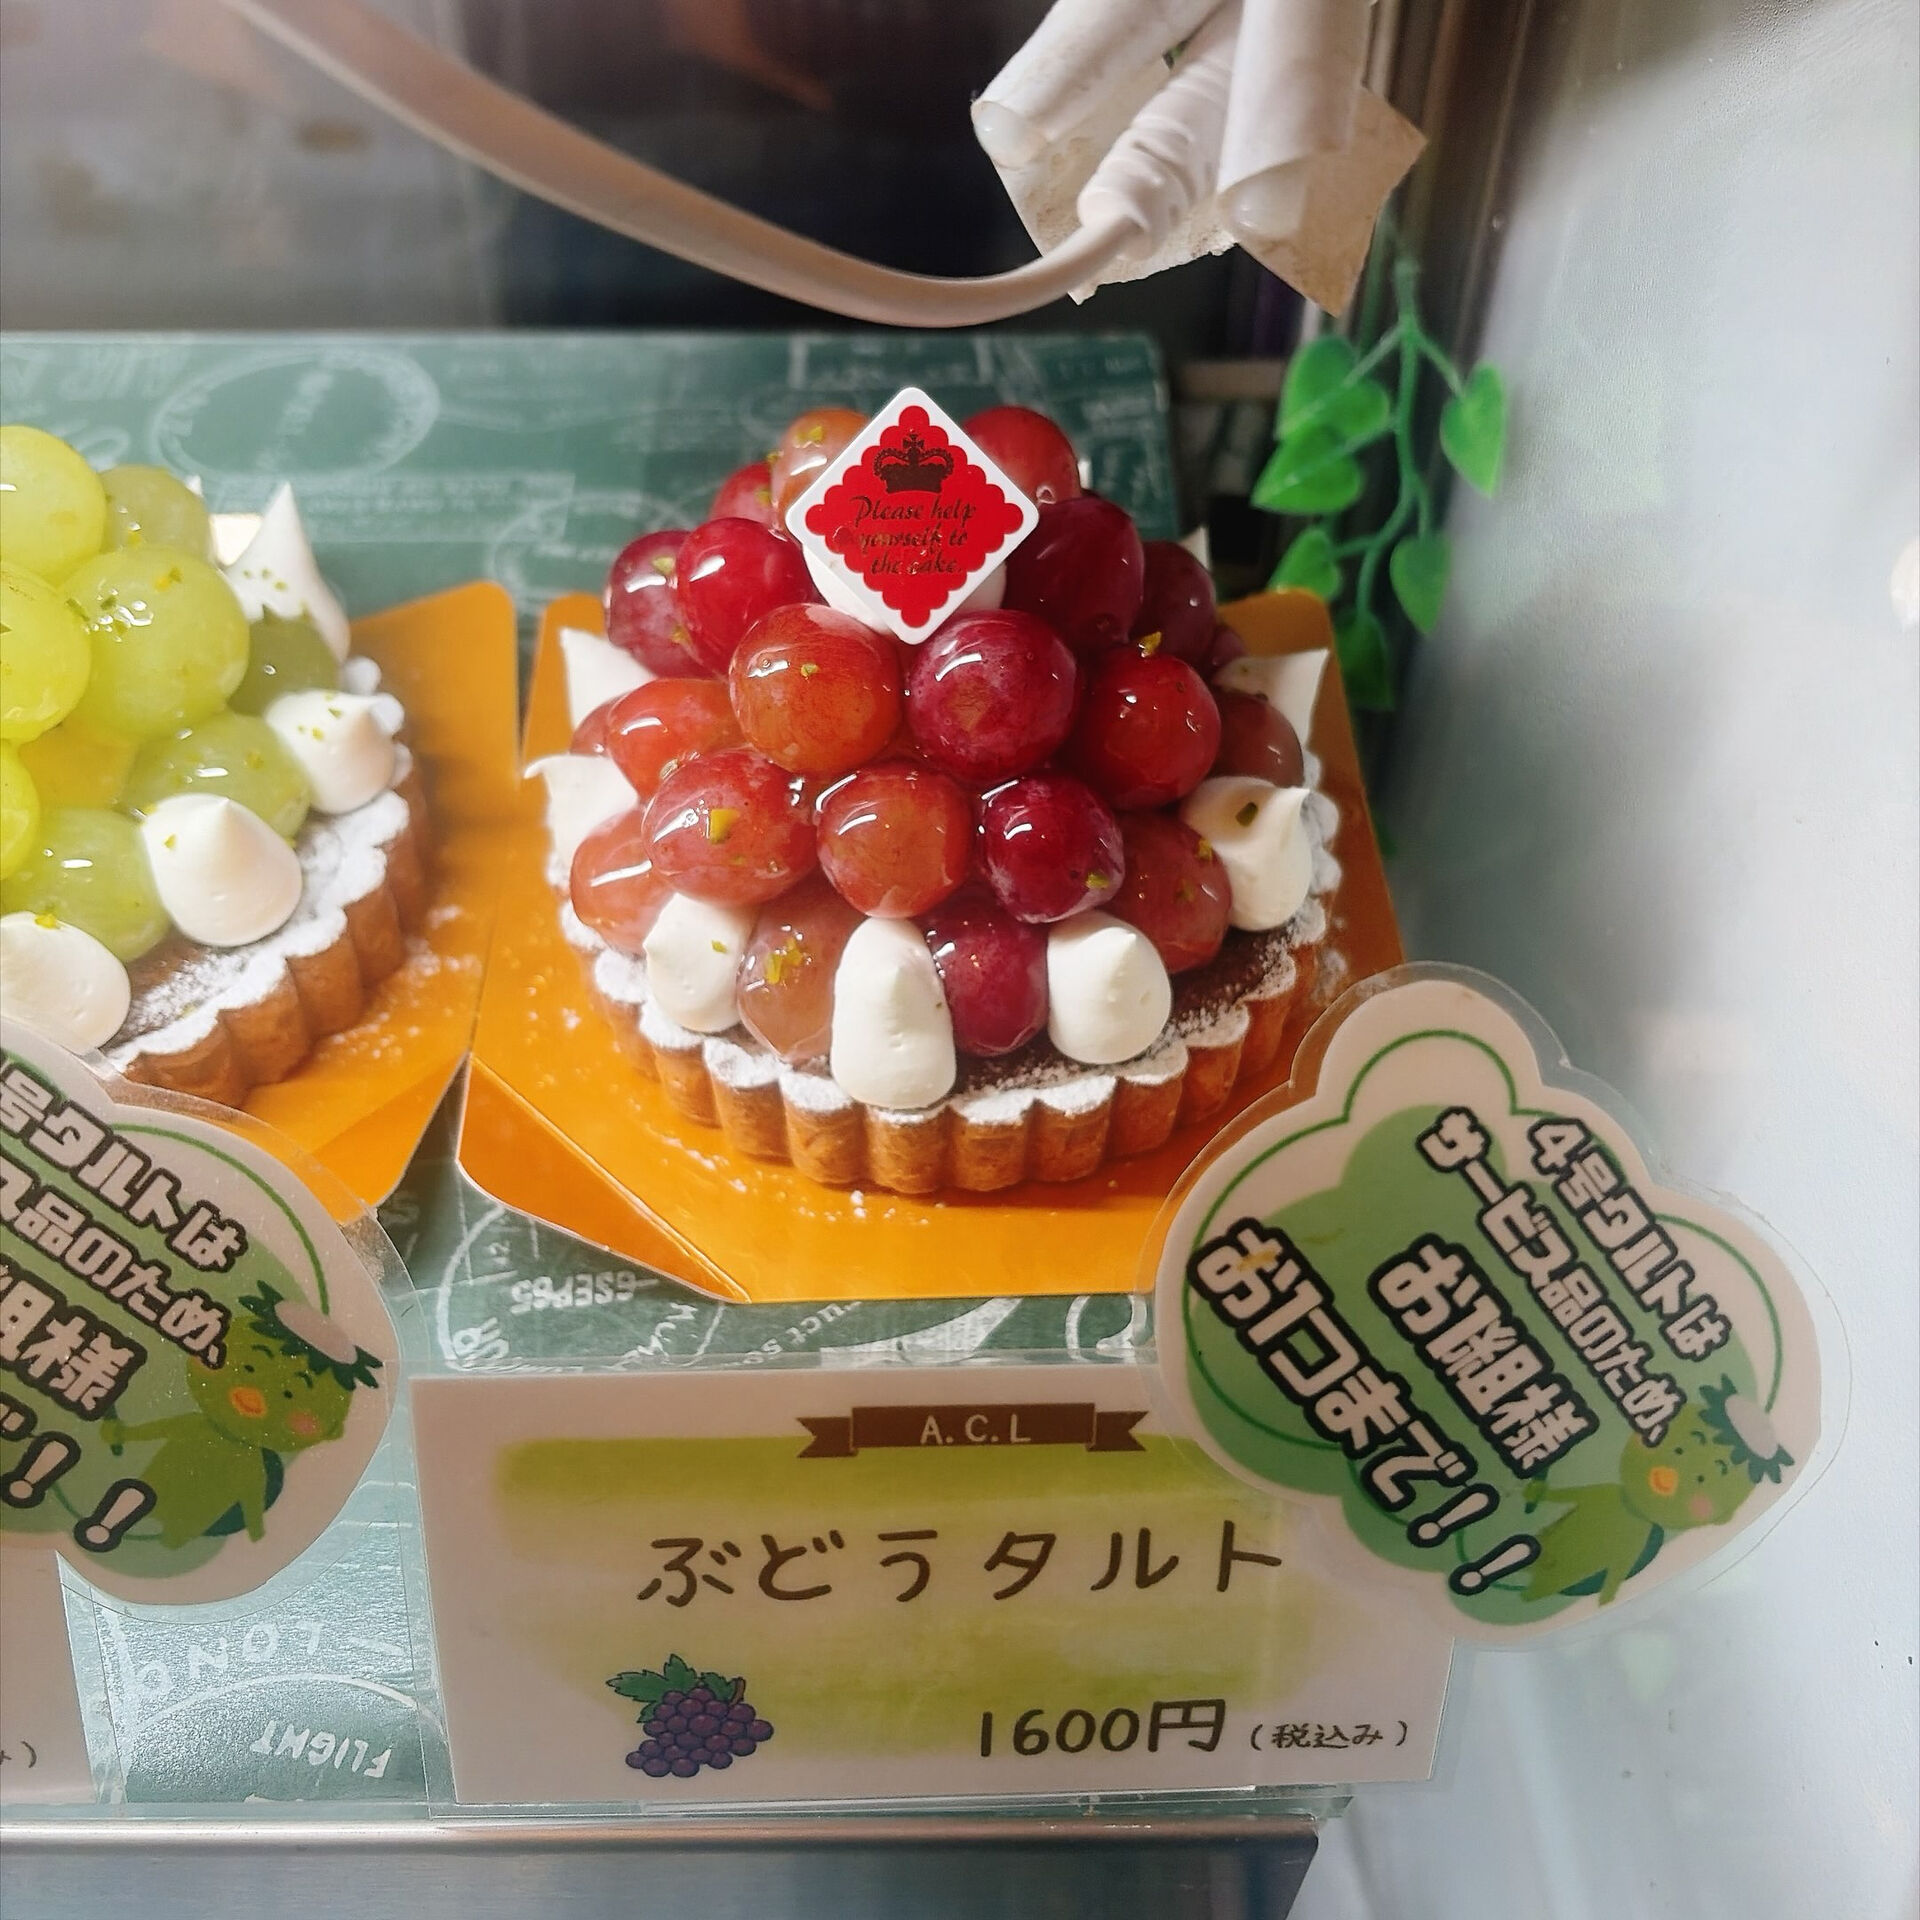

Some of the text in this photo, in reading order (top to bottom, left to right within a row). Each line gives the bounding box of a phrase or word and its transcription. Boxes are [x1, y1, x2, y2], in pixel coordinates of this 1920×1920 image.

[850, 495, 976, 529] Please help
[858, 524, 968, 557] yourself to
[871, 549, 903, 574] the
[920, 1413, 1031, 1445] A.C.L
[637, 1520, 1283, 1607] ぶどうタルト
[980, 1698, 1226, 1758] 1600円
